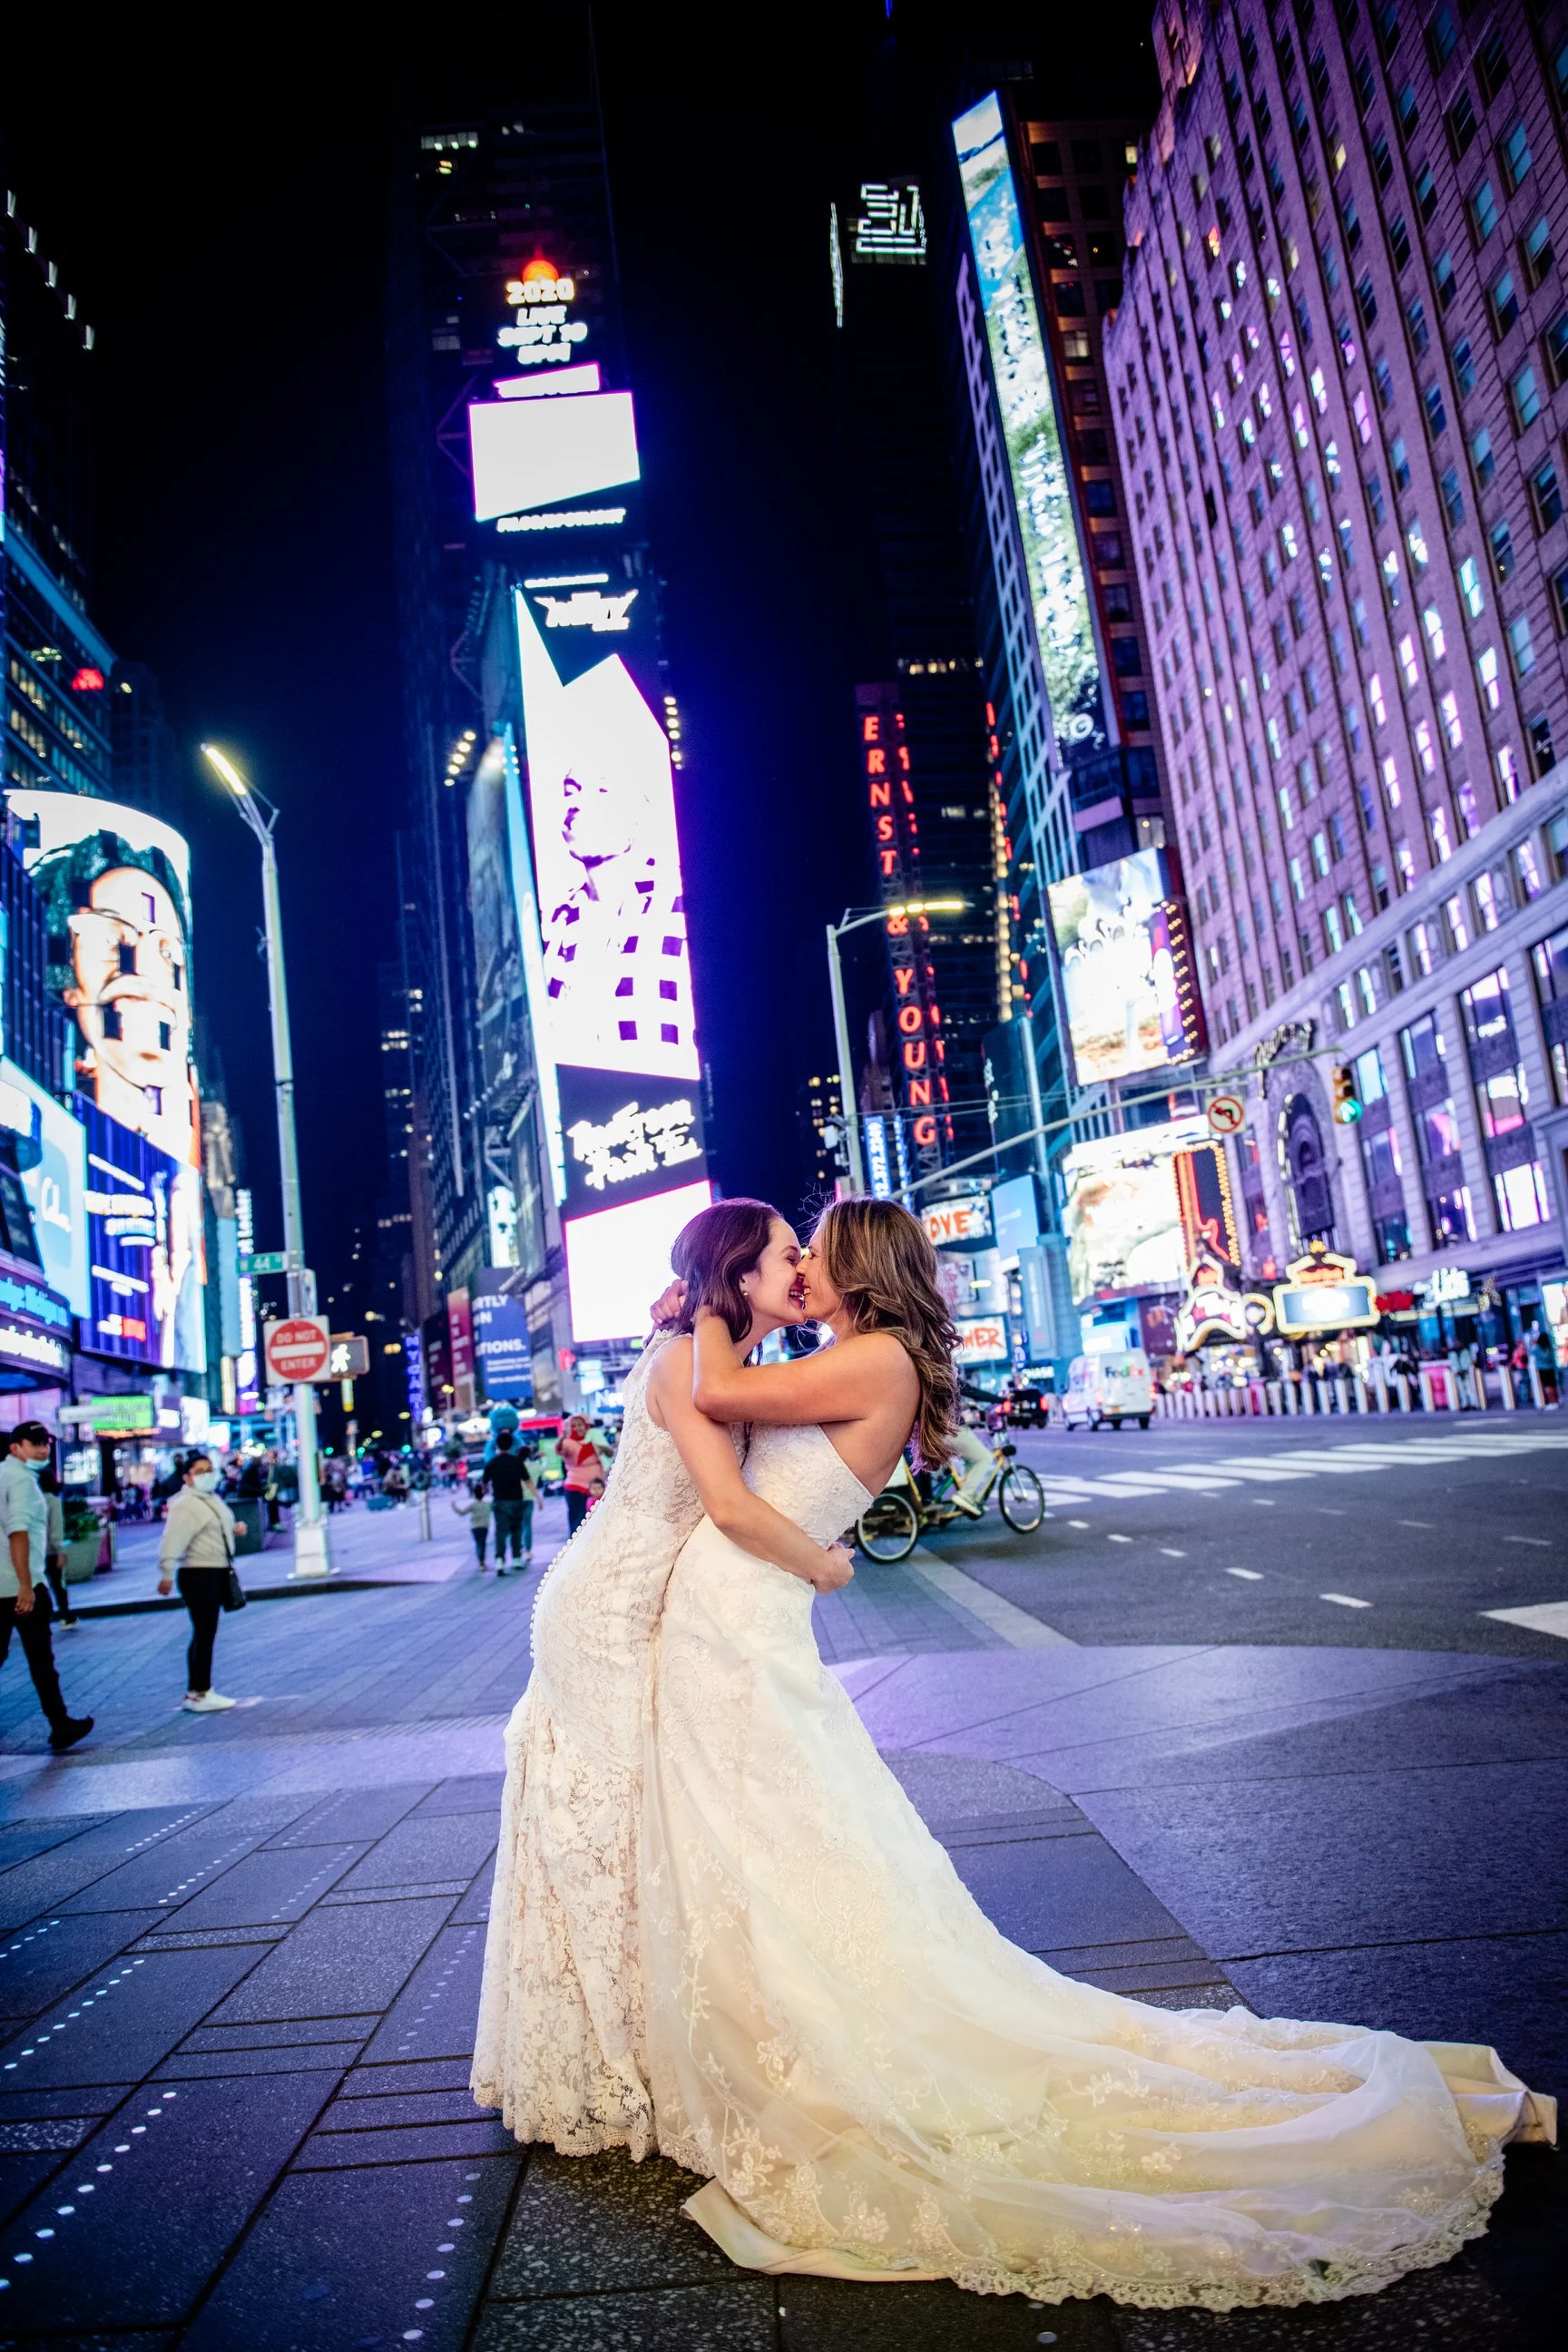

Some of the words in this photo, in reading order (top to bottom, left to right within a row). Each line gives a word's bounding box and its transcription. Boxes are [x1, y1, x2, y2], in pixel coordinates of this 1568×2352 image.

[506, 278, 574, 304] 2020
[864, 715, 897, 876] ERNST
[894, 967, 937, 1145] YOUNG
[253, 1256, 270, 1270] 44
[276, 1332, 293, 1345] DO
[294, 1328, 317, 1342] NOT
[280, 1357, 317, 1371] ENTER
